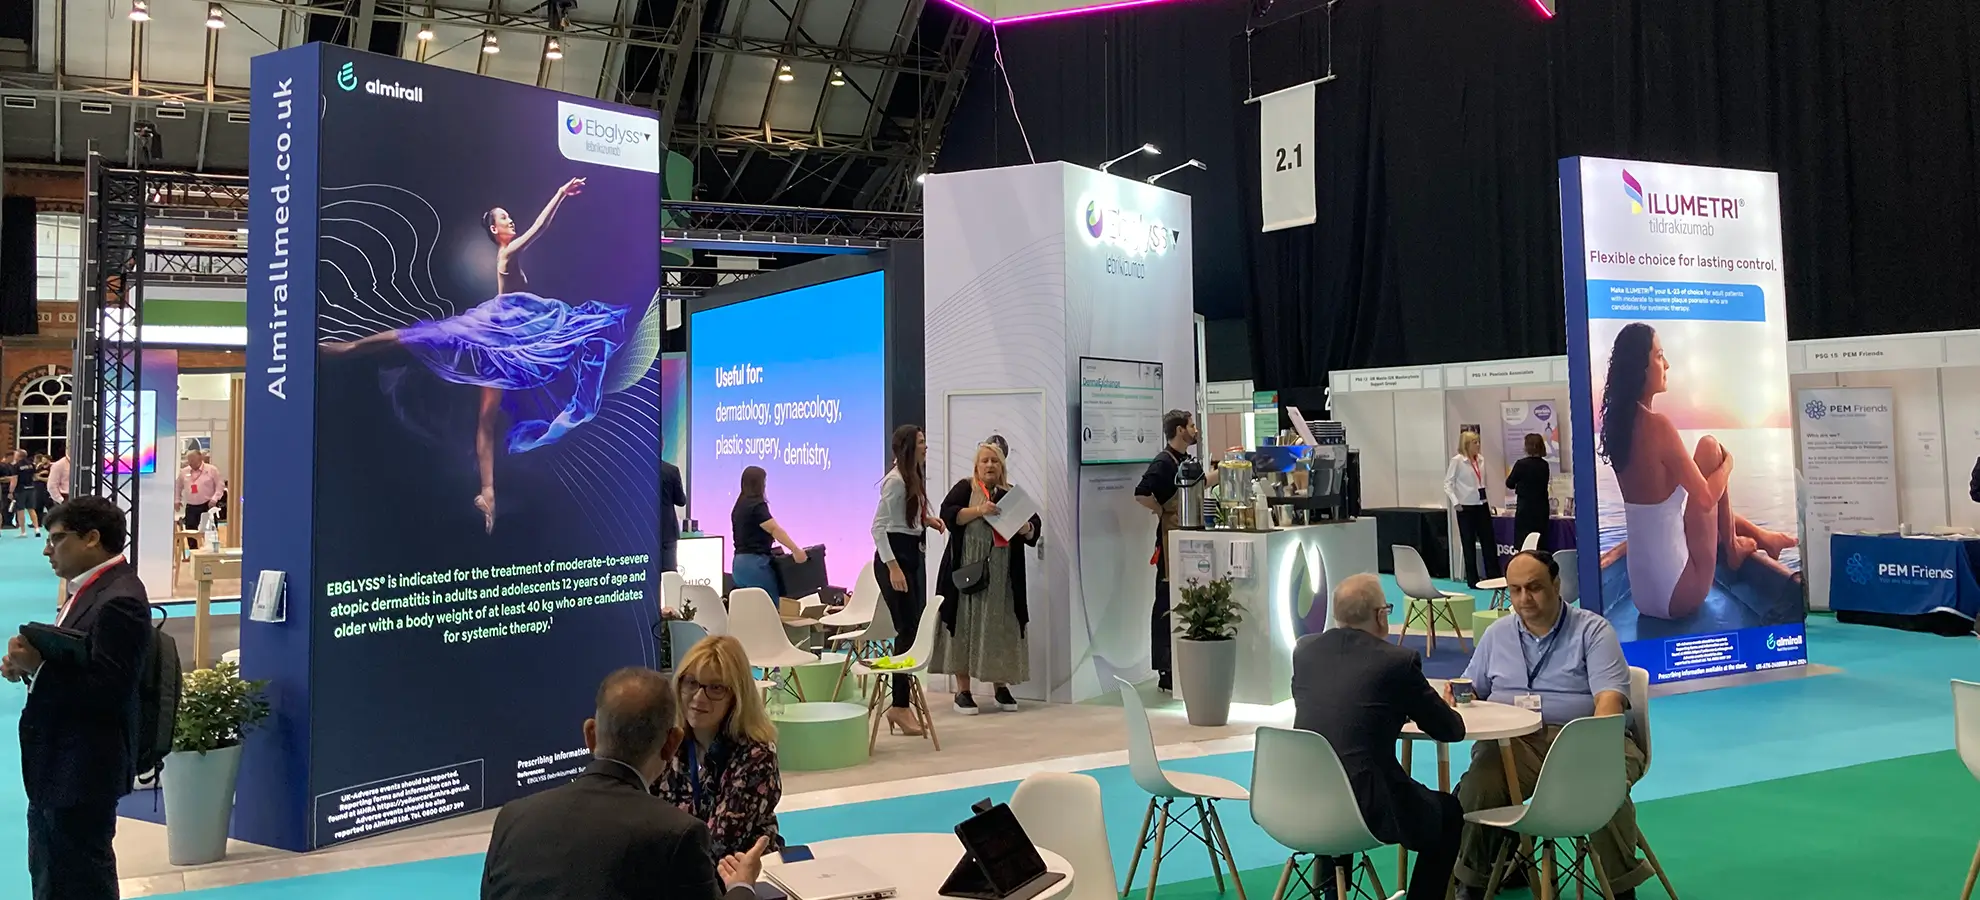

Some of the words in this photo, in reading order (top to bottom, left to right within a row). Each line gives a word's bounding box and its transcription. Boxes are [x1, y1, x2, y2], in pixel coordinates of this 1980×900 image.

[365, 79, 422, 103] almirall
[1276, 143, 1302, 172] 2.1
[267, 77, 293, 400] Almirallmed.co.uk
[1649, 219, 1715, 236] tildrakizumab
[1590, 250, 1636, 265] Flexible
[1638, 253, 1676, 266] choice
[1678, 254, 1695, 267] for
[1697, 255, 1734, 271] lasting
[1736, 258, 1777, 271] control.
[1655, 288, 1667, 296] your
[1687, 288, 1704, 296] choice
[715, 364, 745, 388] Useful
[746, 363, 763, 384] for:
[716, 399, 771, 425] dermatology,
[774, 395, 842, 426] gynaecology,
[1830, 404, 1851, 413] PEM
[1853, 404, 1888, 413] Friends
[716, 434, 743, 460] plastic
[745, 437, 780, 460] surgery,
[784, 442, 831, 471] dentistry,
[388, 574, 397, 588] is
[400, 570, 451, 588] indicated
[453, 568, 469, 582] for
[471, 567, 489, 579] the
[491, 562, 542, 578] treatment
[544, 560, 554, 573] of
[556, 553, 649, 571] moderate-to-severe
[1879, 563, 1908, 577] PEM
[330, 599, 369, 617] atopic
[372, 592, 430, 611] dermatitis
[432, 591, 442, 604] in
[445, 588, 477, 603] adults
[480, 585, 499, 599] and
[502, 580, 560, 596] adolescents
[562, 578, 572, 590] 12
[573, 577, 598, 591] years
[600, 574, 610, 585] of
[611, 573, 627, 587] age
[629, 570, 646, 582] and
[334, 623, 367, 638] older
[369, 617, 394, 633] with
[396, 619, 403, 629] a
[406, 613, 434, 629] body
[436, 609, 473, 625] weight
[475, 606, 487, 619] of
[489, 604, 500, 618] at
[501, 602, 526, 616] least
[527, 600, 540, 612] 40
[542, 599, 554, 613] kg
[555, 597, 576, 609] who
[577, 595, 593, 607] are
[594, 589, 643, 605] candidates
[443, 630, 460, 643] for
[462, 623, 507, 643] systemic
[1776, 634, 1803, 648] almirall
[517, 754, 554, 769] Prescribing
[339, 797, 372, 811] Reporting
[373, 793, 392, 804] forms
[392, 789, 404, 799] and
[405, 782, 440, 797] information
[441, 780, 451, 788] can
[452, 778, 460, 787] be
[340, 787, 379, 803] UK-Adverse
[380, 783, 400, 794] events
[401, 777, 422, 790] should
[423, 775, 430, 784] be
[431, 770, 459, 783] reported.
[328, 812, 348, 823] found
[349, 808, 356, 818] at
[357, 804, 376, 816] MHRA
[335, 823, 364, 839] reported
[365, 821, 373, 831] to
[373, 817, 397, 829] Almirall
[423, 807, 438, 817] 0800
[355, 812, 382, 825] Adverse
[383, 807, 403, 818] events
[404, 802, 425, 814] should
[425, 800, 433, 809] be
[434, 798, 446, 807] also
